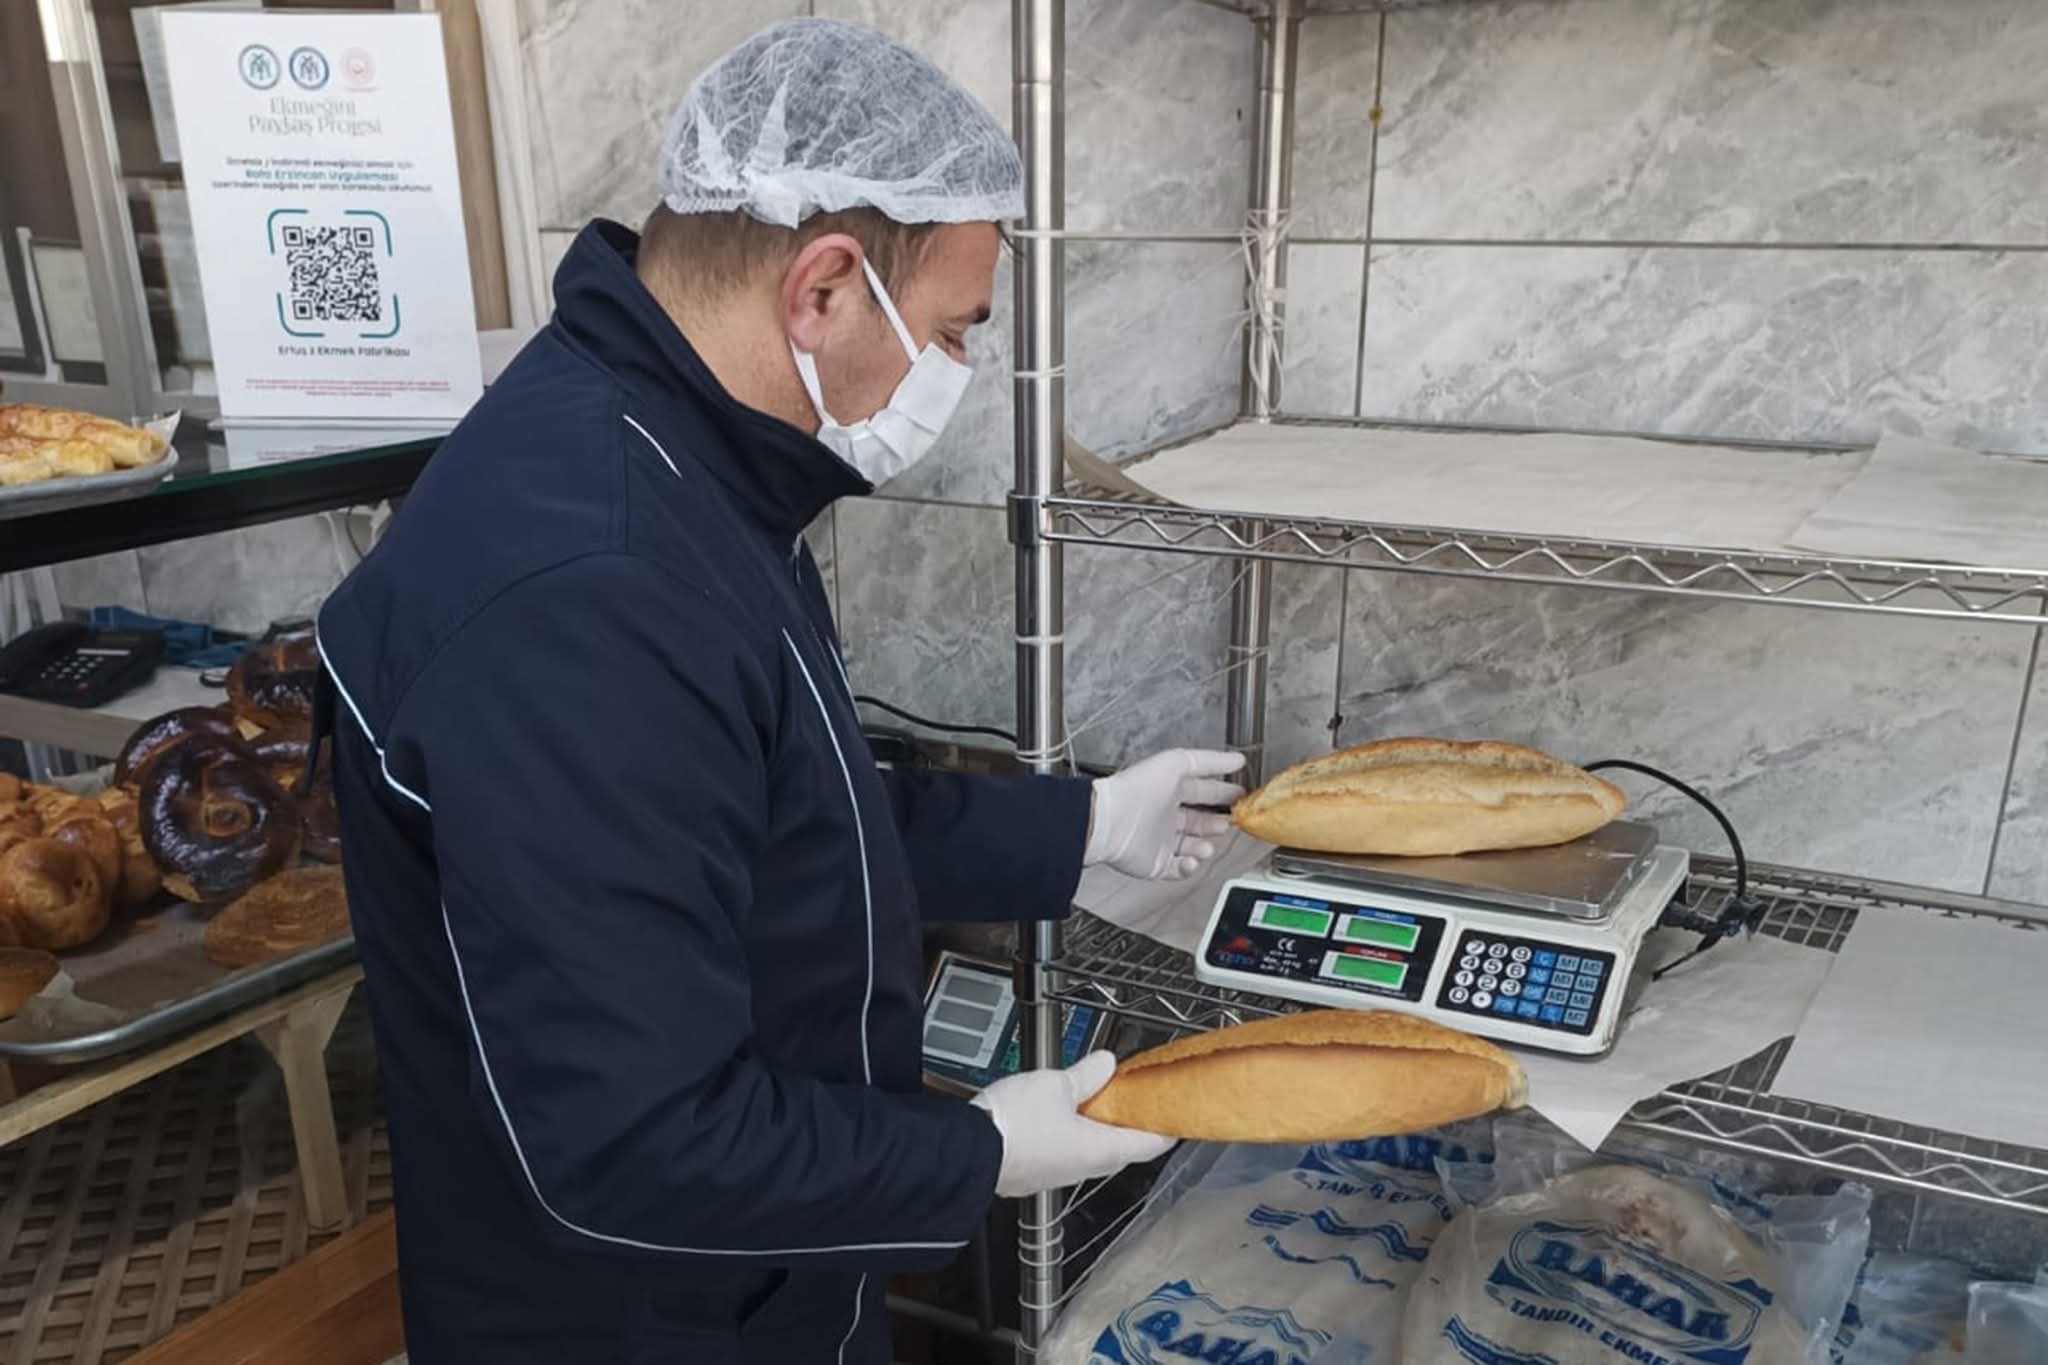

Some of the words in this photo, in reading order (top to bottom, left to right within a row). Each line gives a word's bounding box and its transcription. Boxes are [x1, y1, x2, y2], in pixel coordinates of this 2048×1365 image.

[1510, 1298, 1595, 1333] TANDIR
[1535, 1239, 1731, 1341] BAHAR
[1132, 1310, 1308, 1365] BAHA
